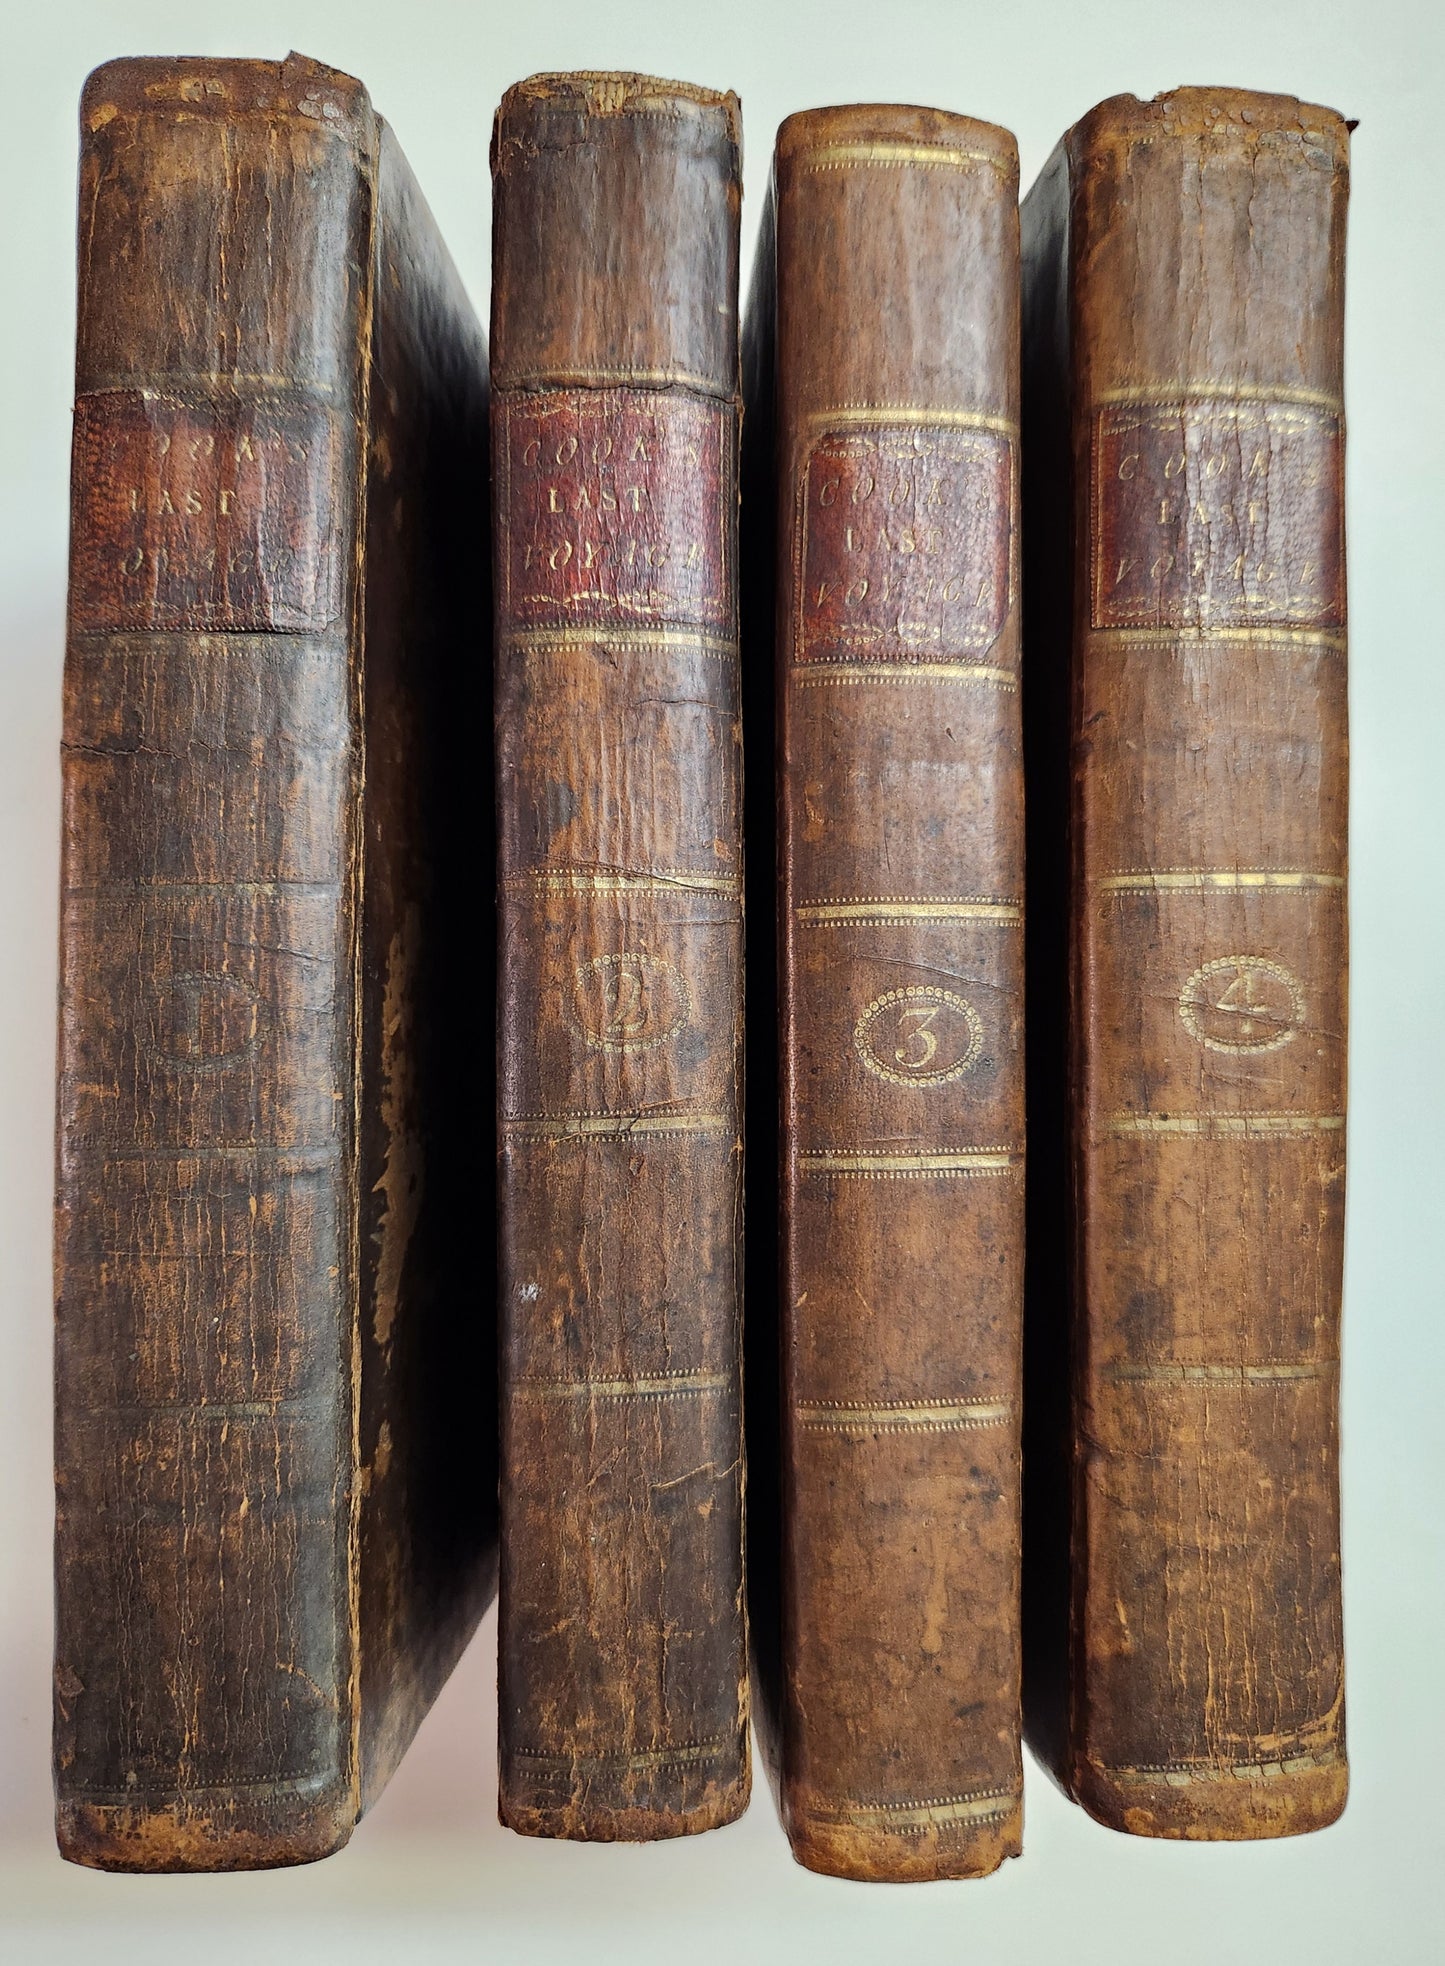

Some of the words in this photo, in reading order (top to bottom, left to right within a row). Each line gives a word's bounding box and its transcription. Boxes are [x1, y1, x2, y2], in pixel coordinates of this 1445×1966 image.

[547, 486, 648, 514] LAST
[1156, 500, 1263, 527] LAST
[843, 527, 943, 555] LAST
[1115, 551, 1317, 586] VOYAGE
[605, 972, 649, 1034] 2
[1215, 970, 1268, 1035] 4
[894, 1005, 941, 1068] 3
